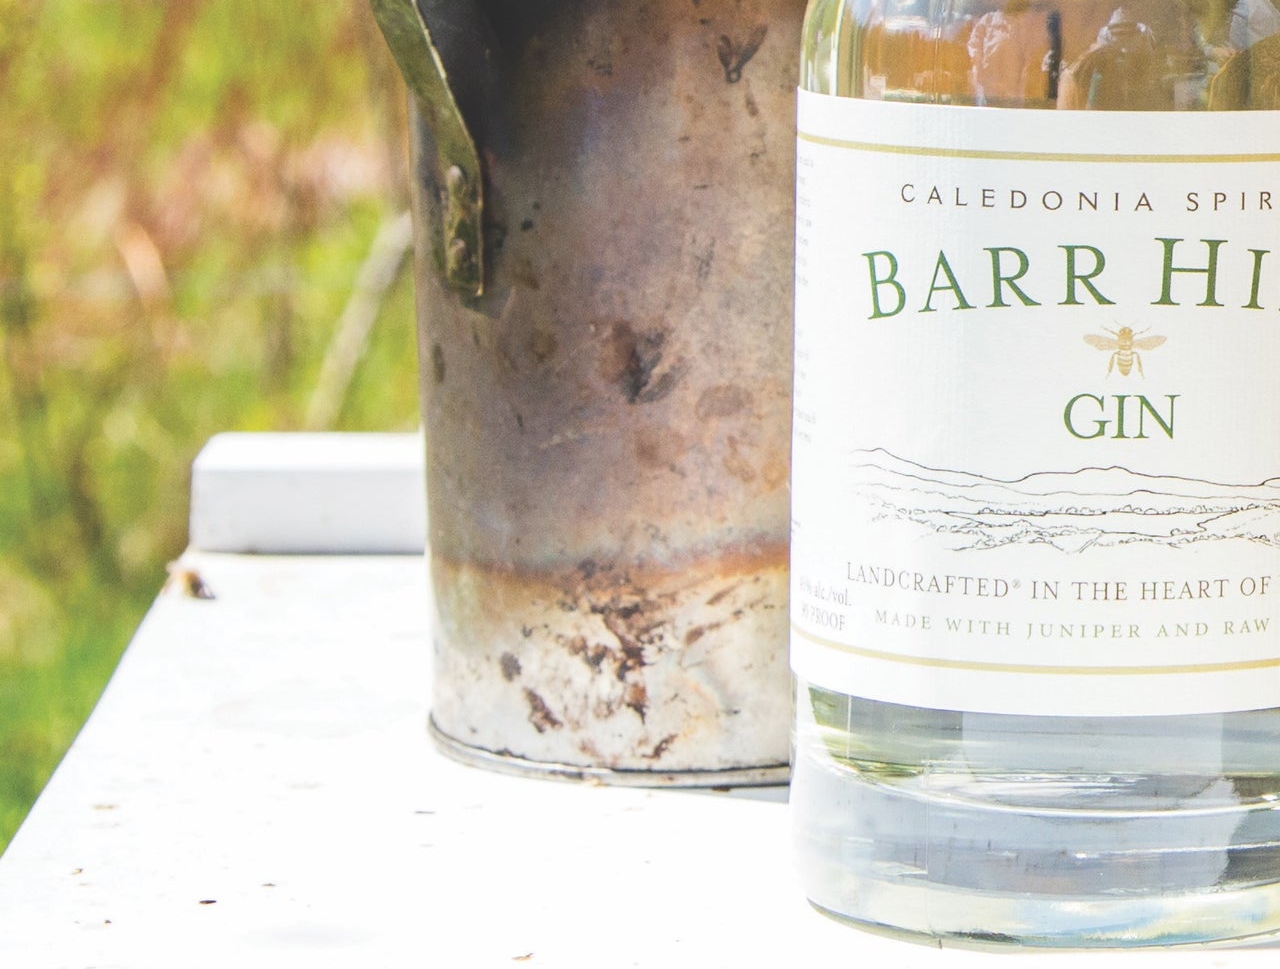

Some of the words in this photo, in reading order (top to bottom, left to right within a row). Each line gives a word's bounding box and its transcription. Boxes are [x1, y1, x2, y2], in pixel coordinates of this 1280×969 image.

[899, 182, 1154, 213] CALEDONIA
[861, 243, 1117, 321] BARR
[1062, 392, 1181, 441] GIN
[1030, 579, 1060, 601] IN
[1071, 580, 1128, 602] THE
[1140, 578, 1230, 601] HEART
[1239, 576, 1272, 597] OF
[874, 610, 933, 630] MADE
[946, 617, 1010, 636] WITH
[1027, 622, 1141, 639] JUNIPER
[1156, 622, 1209, 639] AND
[1223, 617, 1270, 635] RAW
